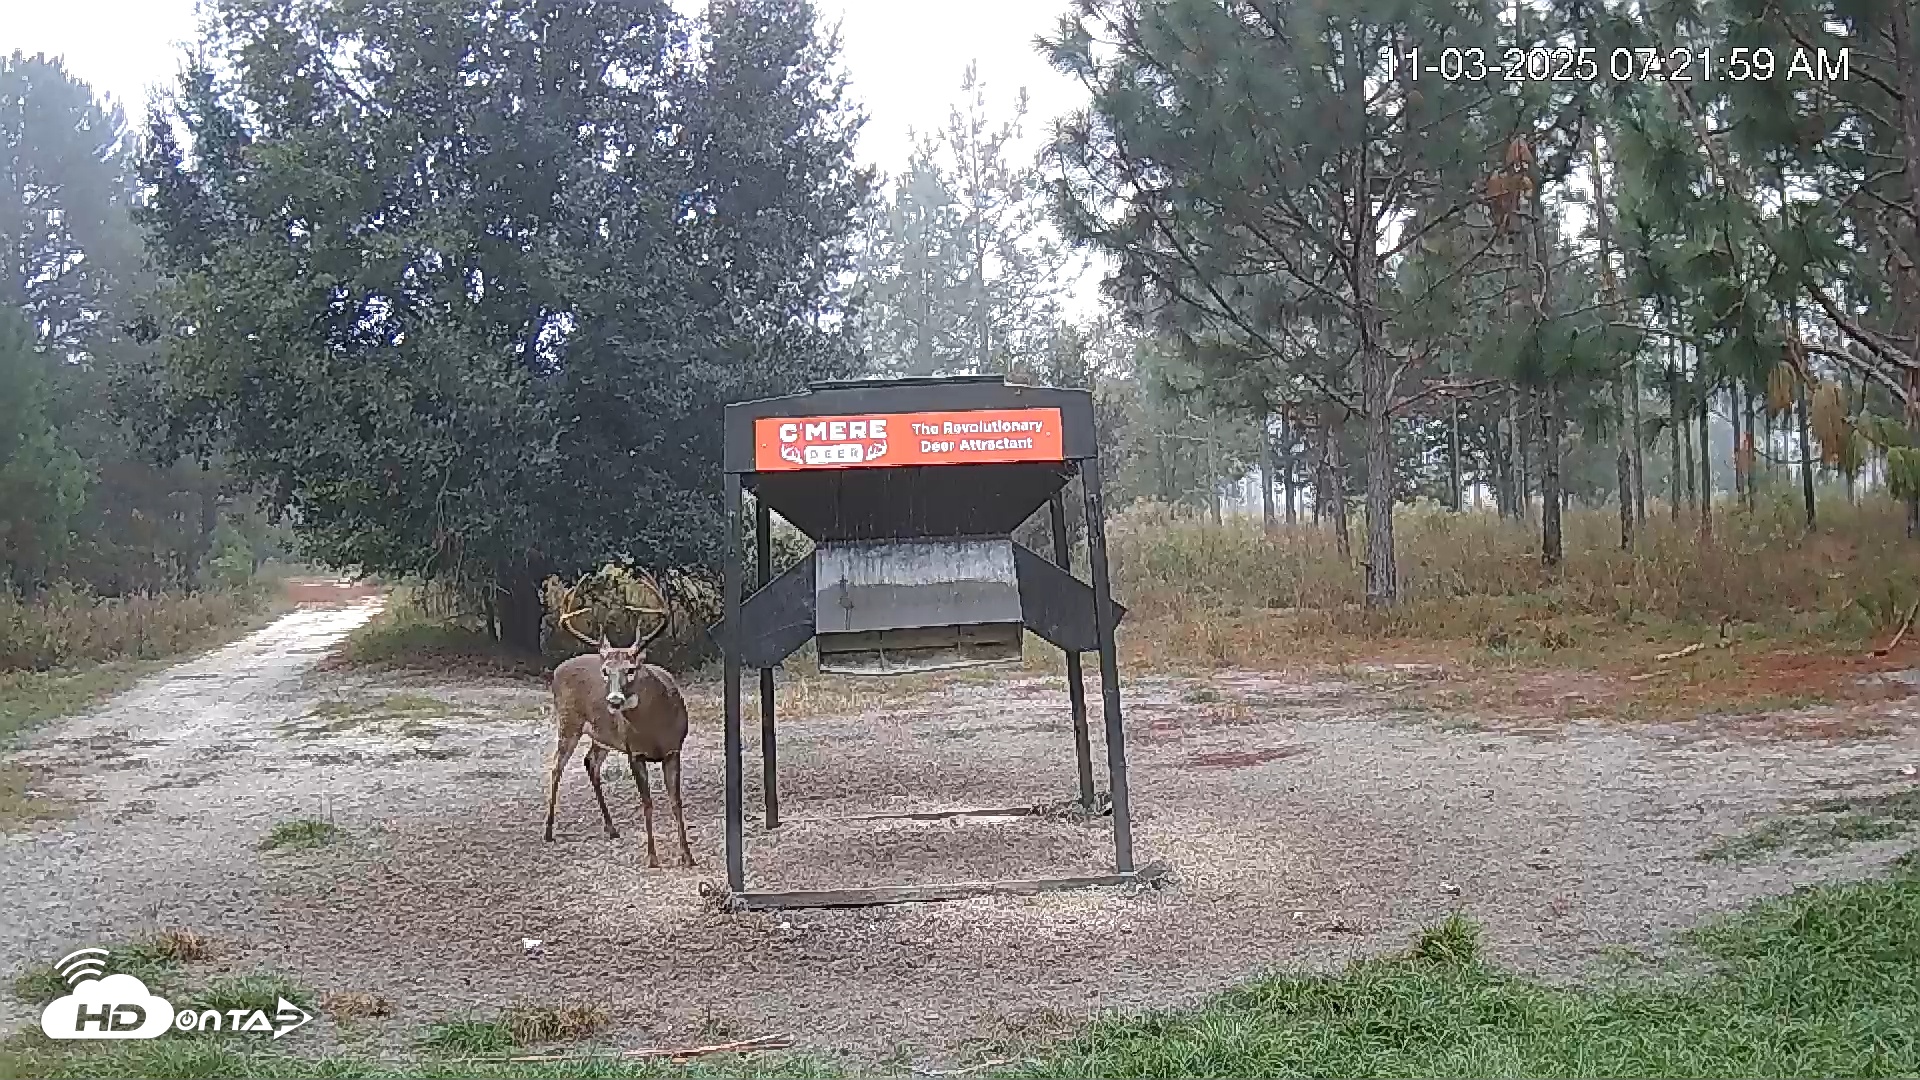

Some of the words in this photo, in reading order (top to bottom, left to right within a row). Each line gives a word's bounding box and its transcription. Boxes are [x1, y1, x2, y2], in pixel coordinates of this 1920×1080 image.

[779, 419, 887, 443] C'MERE
[911, 422, 939, 435] The
[943, 419, 1043, 435] Revolutionary
[920, 439, 955, 453] Deer
[959, 437, 1033, 451] Attractant
[809, 447, 859, 460] DEER
